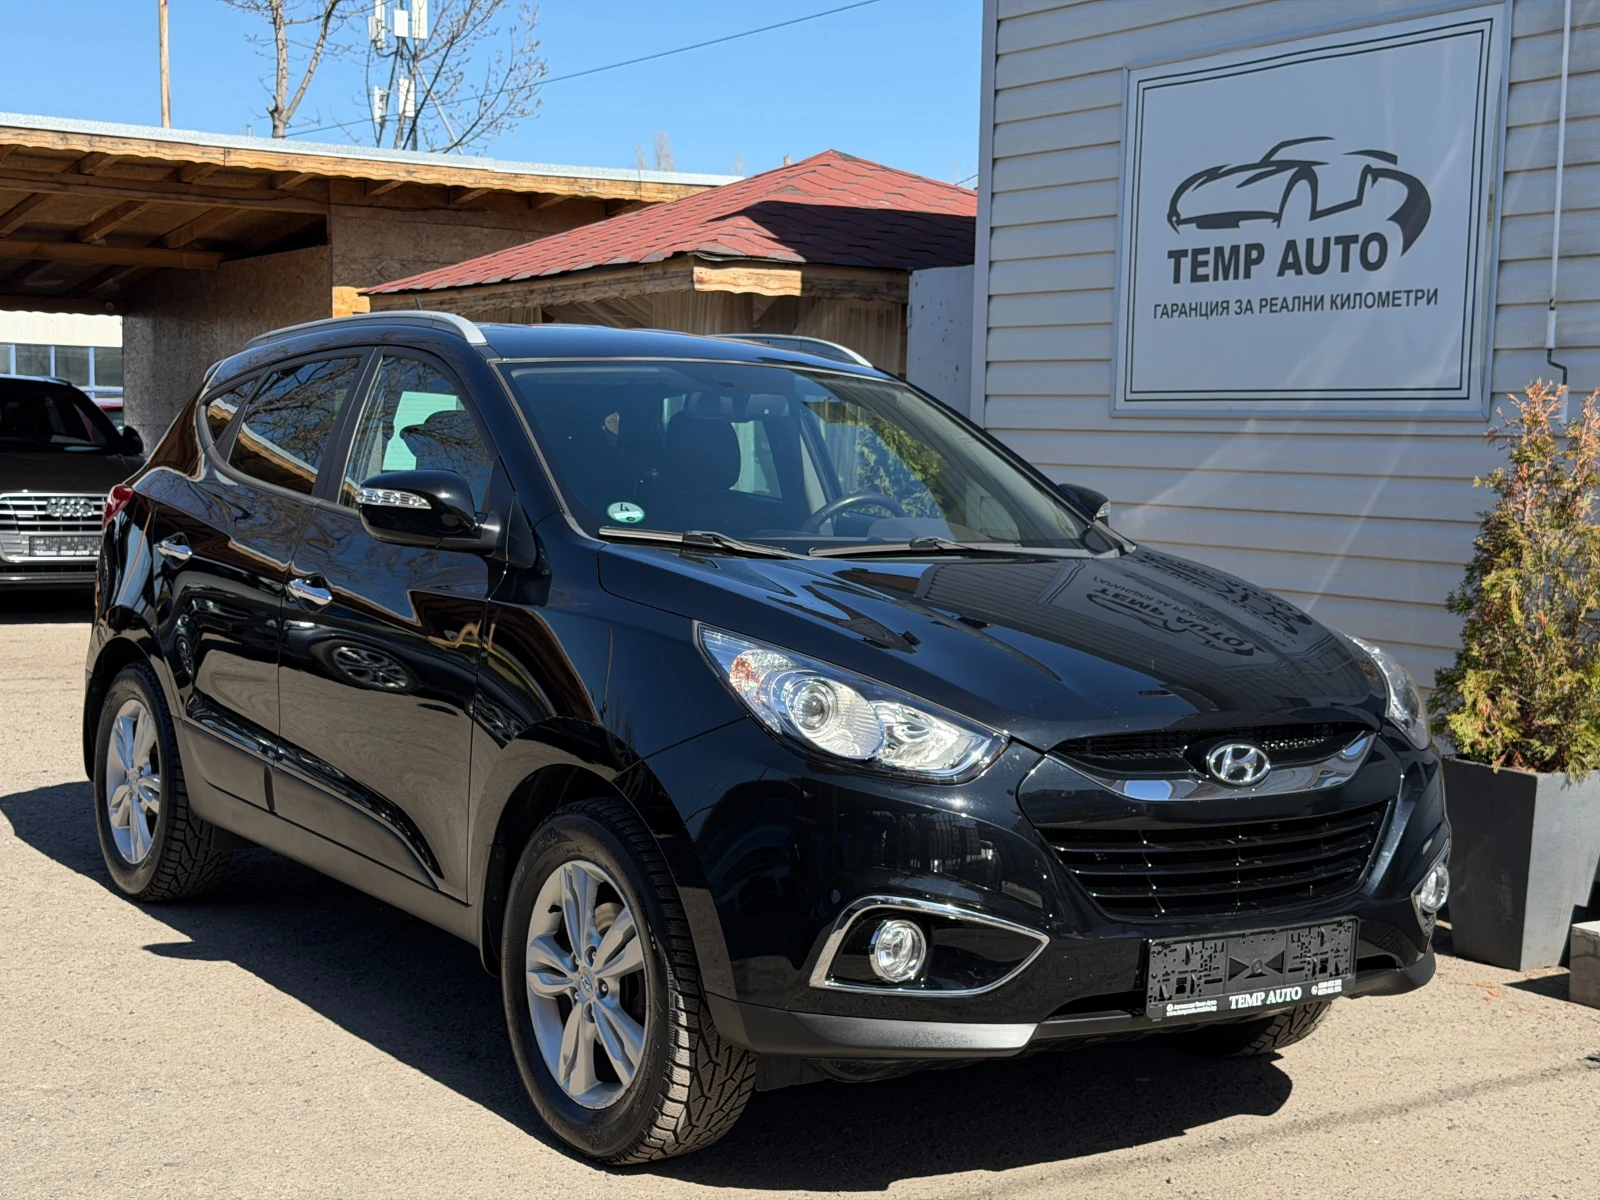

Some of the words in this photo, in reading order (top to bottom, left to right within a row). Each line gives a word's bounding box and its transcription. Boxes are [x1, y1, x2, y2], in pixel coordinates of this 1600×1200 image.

[1167, 242, 1265, 284] TEMP
[1276, 232, 1388, 277] AUTO
[1153, 300, 1230, 320] ГАРАНЦИЯ
[1234, 298, 1254, 315] ЗА
[1258, 295, 1325, 314] РЕАЛНИ
[1330, 288, 1439, 311] КИЛОМЕТРИ
[1229, 991, 1265, 1009] TEMP
[1266, 986, 1302, 1004] AUTO
